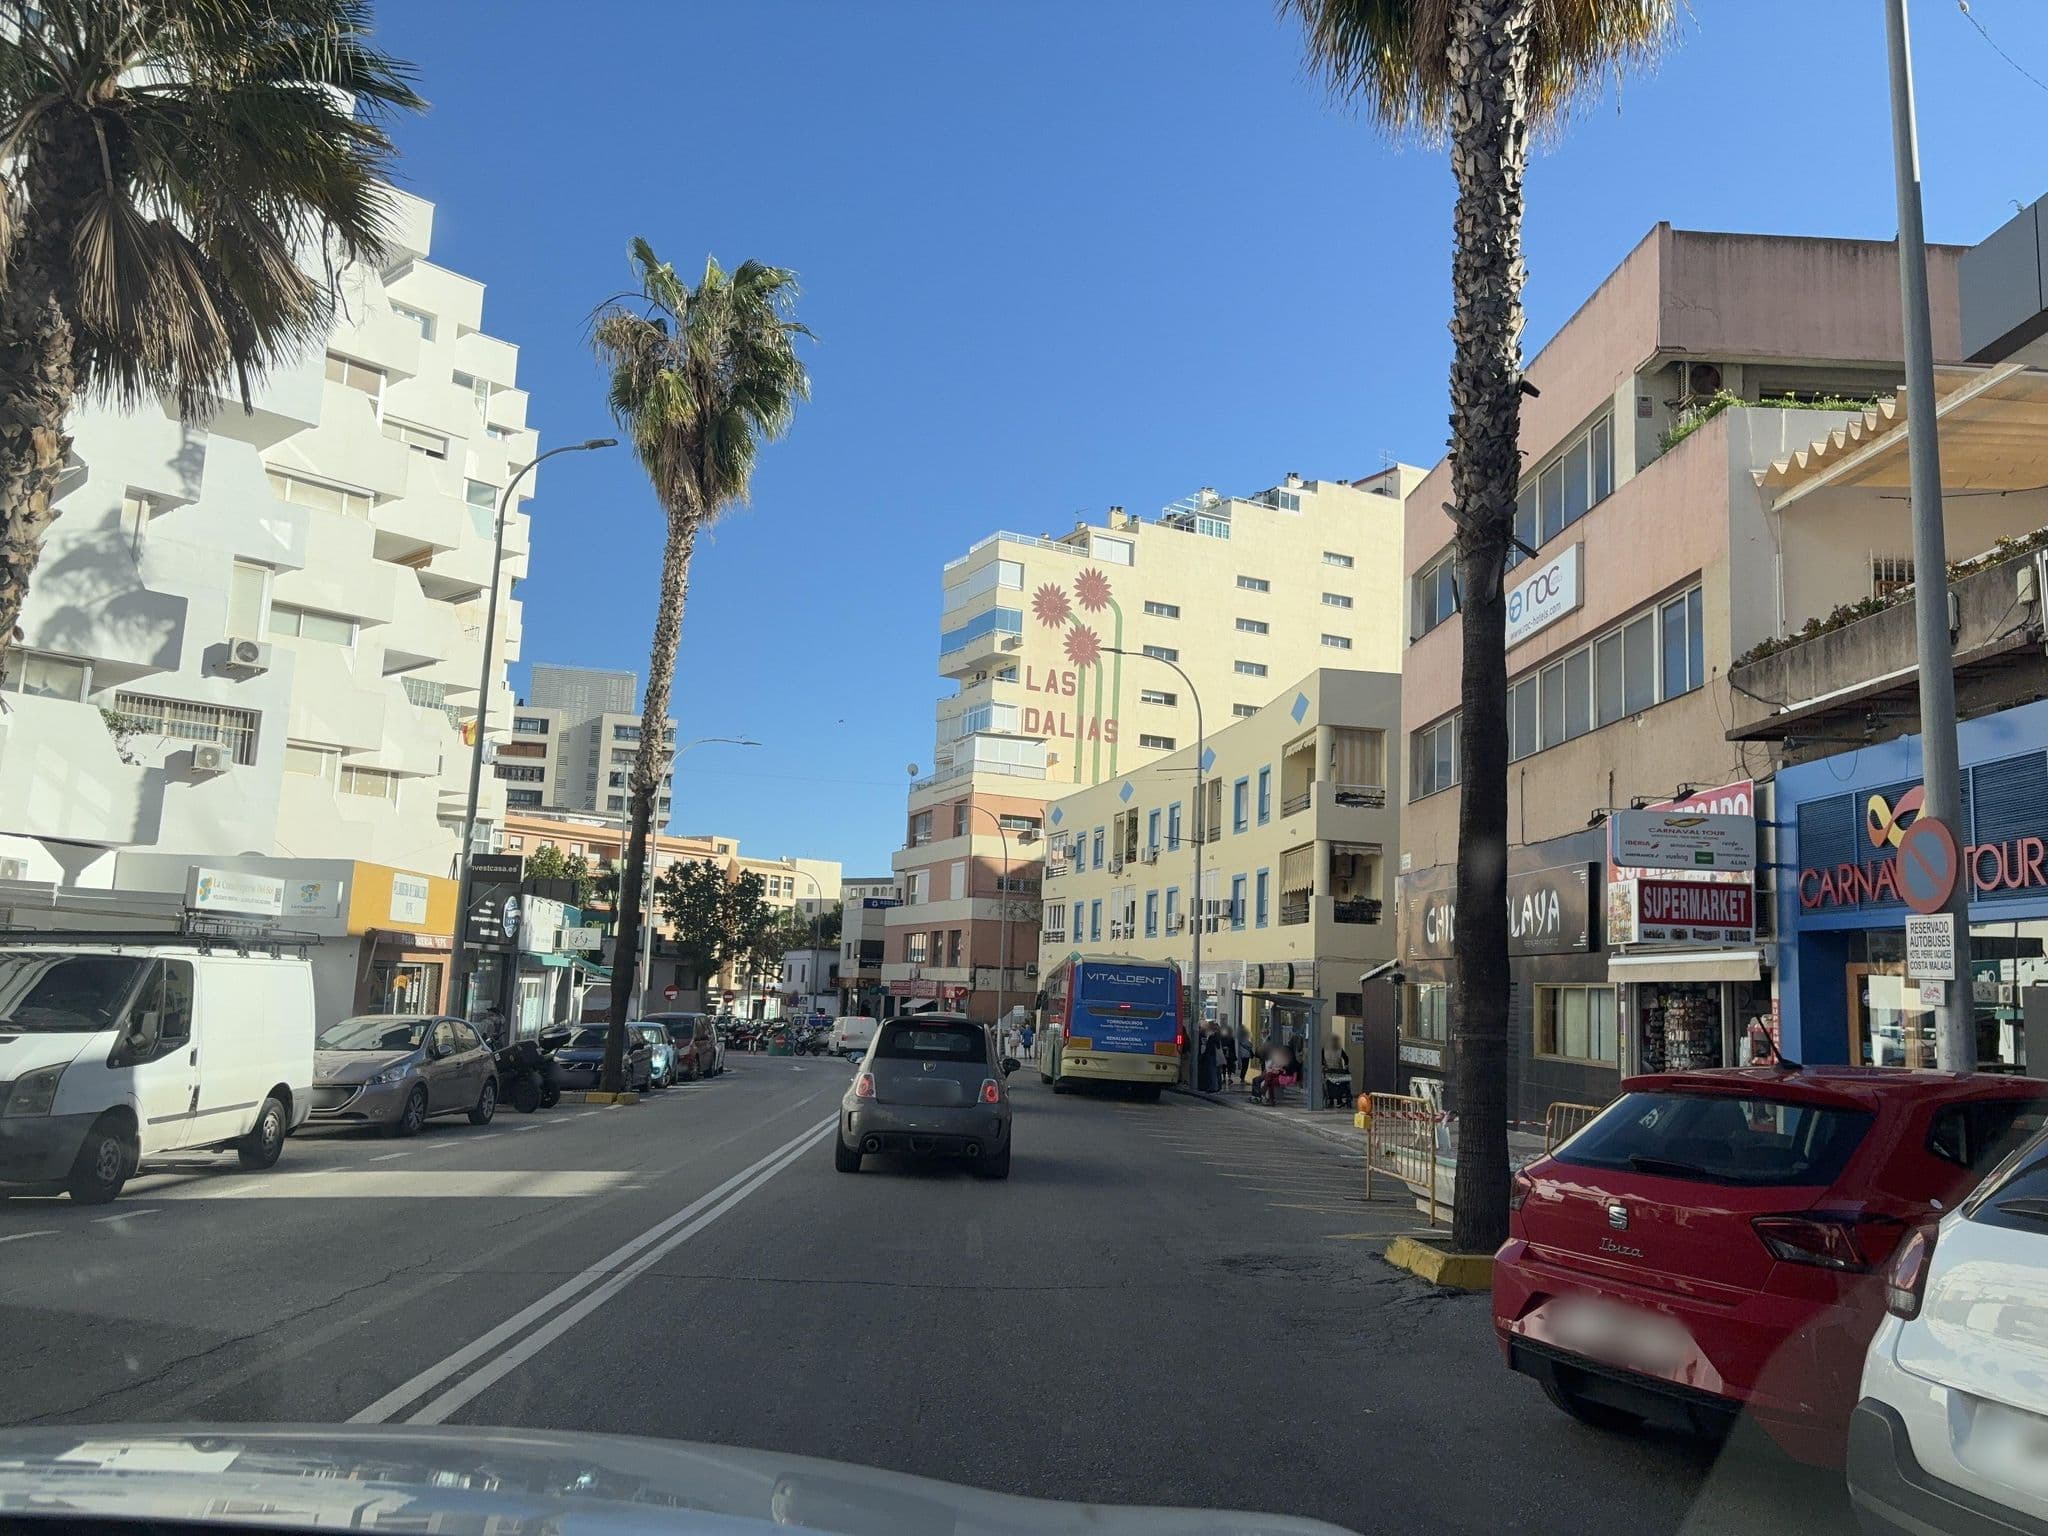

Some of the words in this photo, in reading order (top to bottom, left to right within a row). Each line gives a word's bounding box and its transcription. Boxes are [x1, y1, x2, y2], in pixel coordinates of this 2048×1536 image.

[1526, 565, 1560, 612] roc
[1026, 665, 1076, 697] LAS
[1024, 708, 1119, 744] DALIAS
[1964, 837, 2047, 892] TOUR
[1643, 886, 1746, 922] SUPERMARKET
[1910, 921, 1949, 935] RESERVADO
[1910, 935, 1951, 948] AUTOBUSES
[1086, 972, 1166, 985] VITALDENT
[1910, 961, 1928, 970] COSTA
[1929, 961, 1952, 970] MALAGA
[1599, 1237, 1644, 1258] Ibiza
